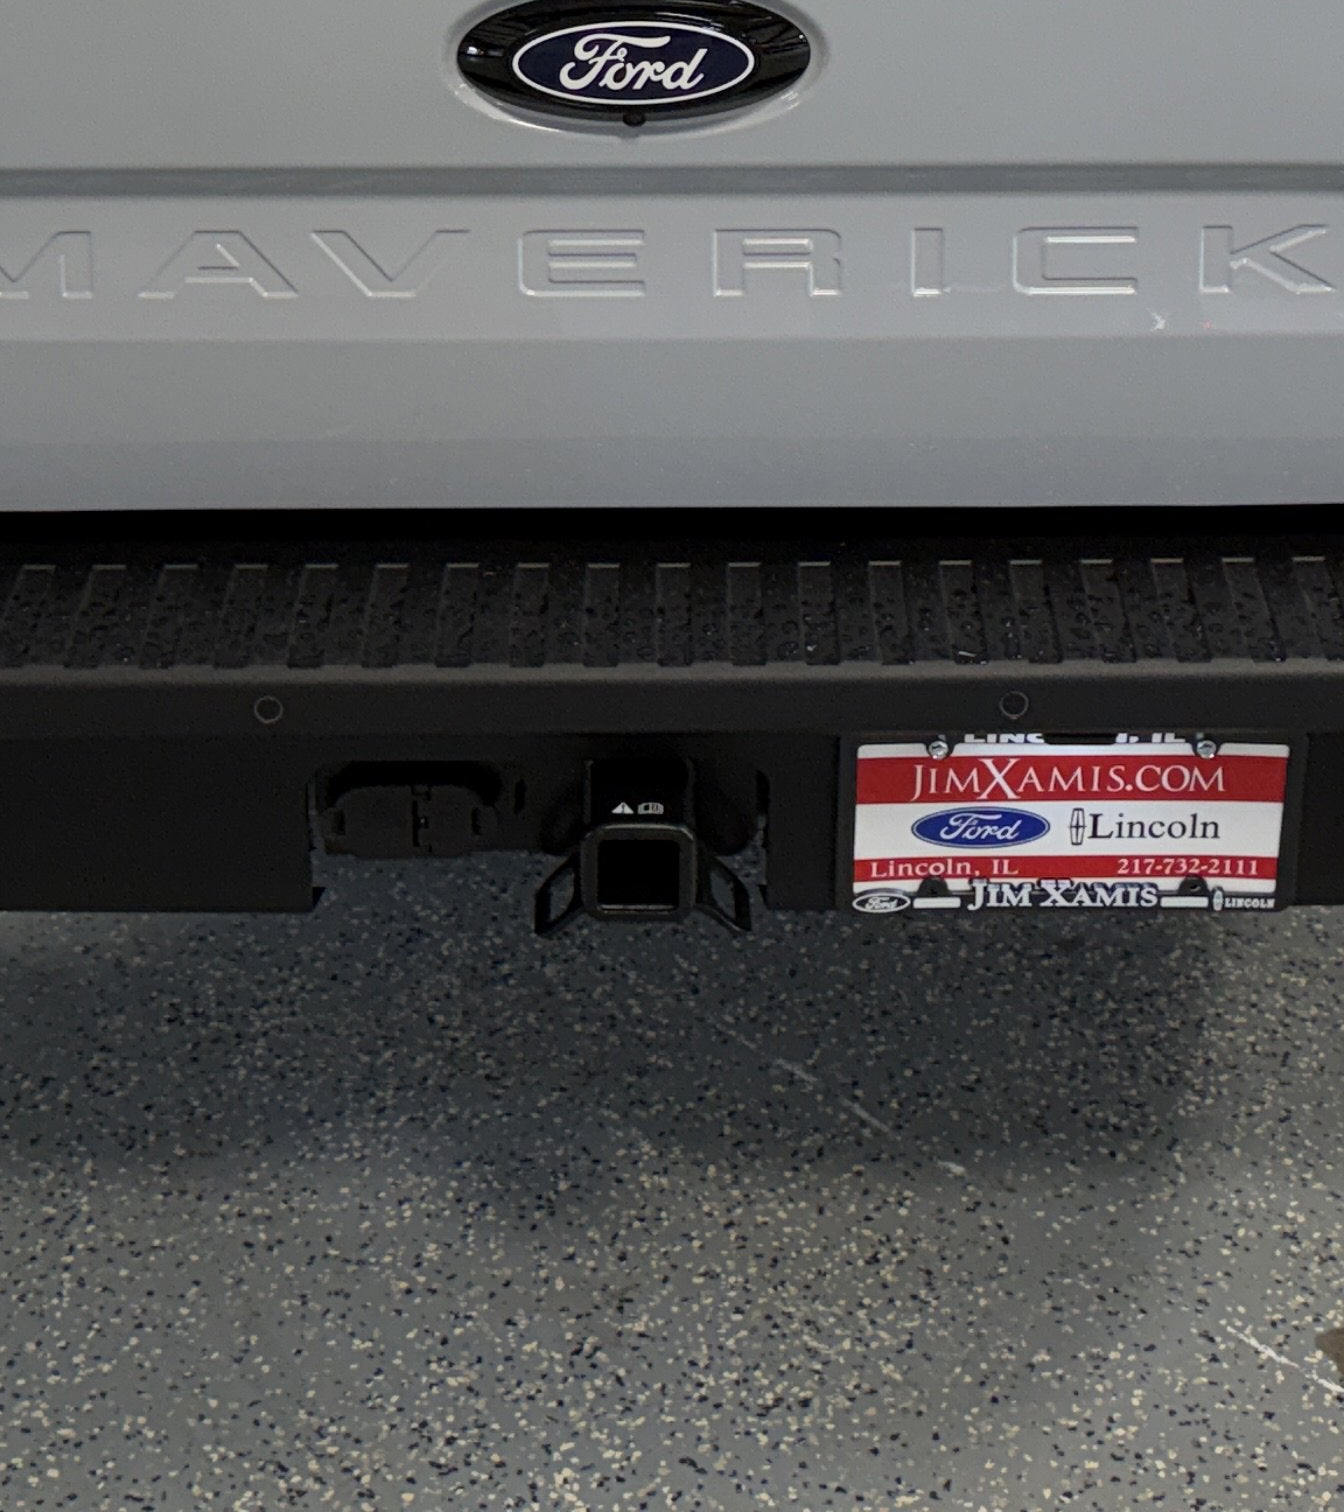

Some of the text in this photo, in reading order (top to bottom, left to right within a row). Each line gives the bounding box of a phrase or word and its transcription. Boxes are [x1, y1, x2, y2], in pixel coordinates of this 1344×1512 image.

[559, 33, 708, 90] Ford
[910, 757, 1226, 801] JIMXAMIS.COM
[939, 813, 1023, 840] Ford
[1088, 813, 1221, 839] Lincoln
[870, 858, 1019, 878] Lincoln, IL
[1117, 858, 1259, 875] 217-732-2111
[864, 896, 899, 910] Ford
[967, 879, 1158, 911] JIM XAMIS
[1224, 897, 1276, 909] LINCOLN
